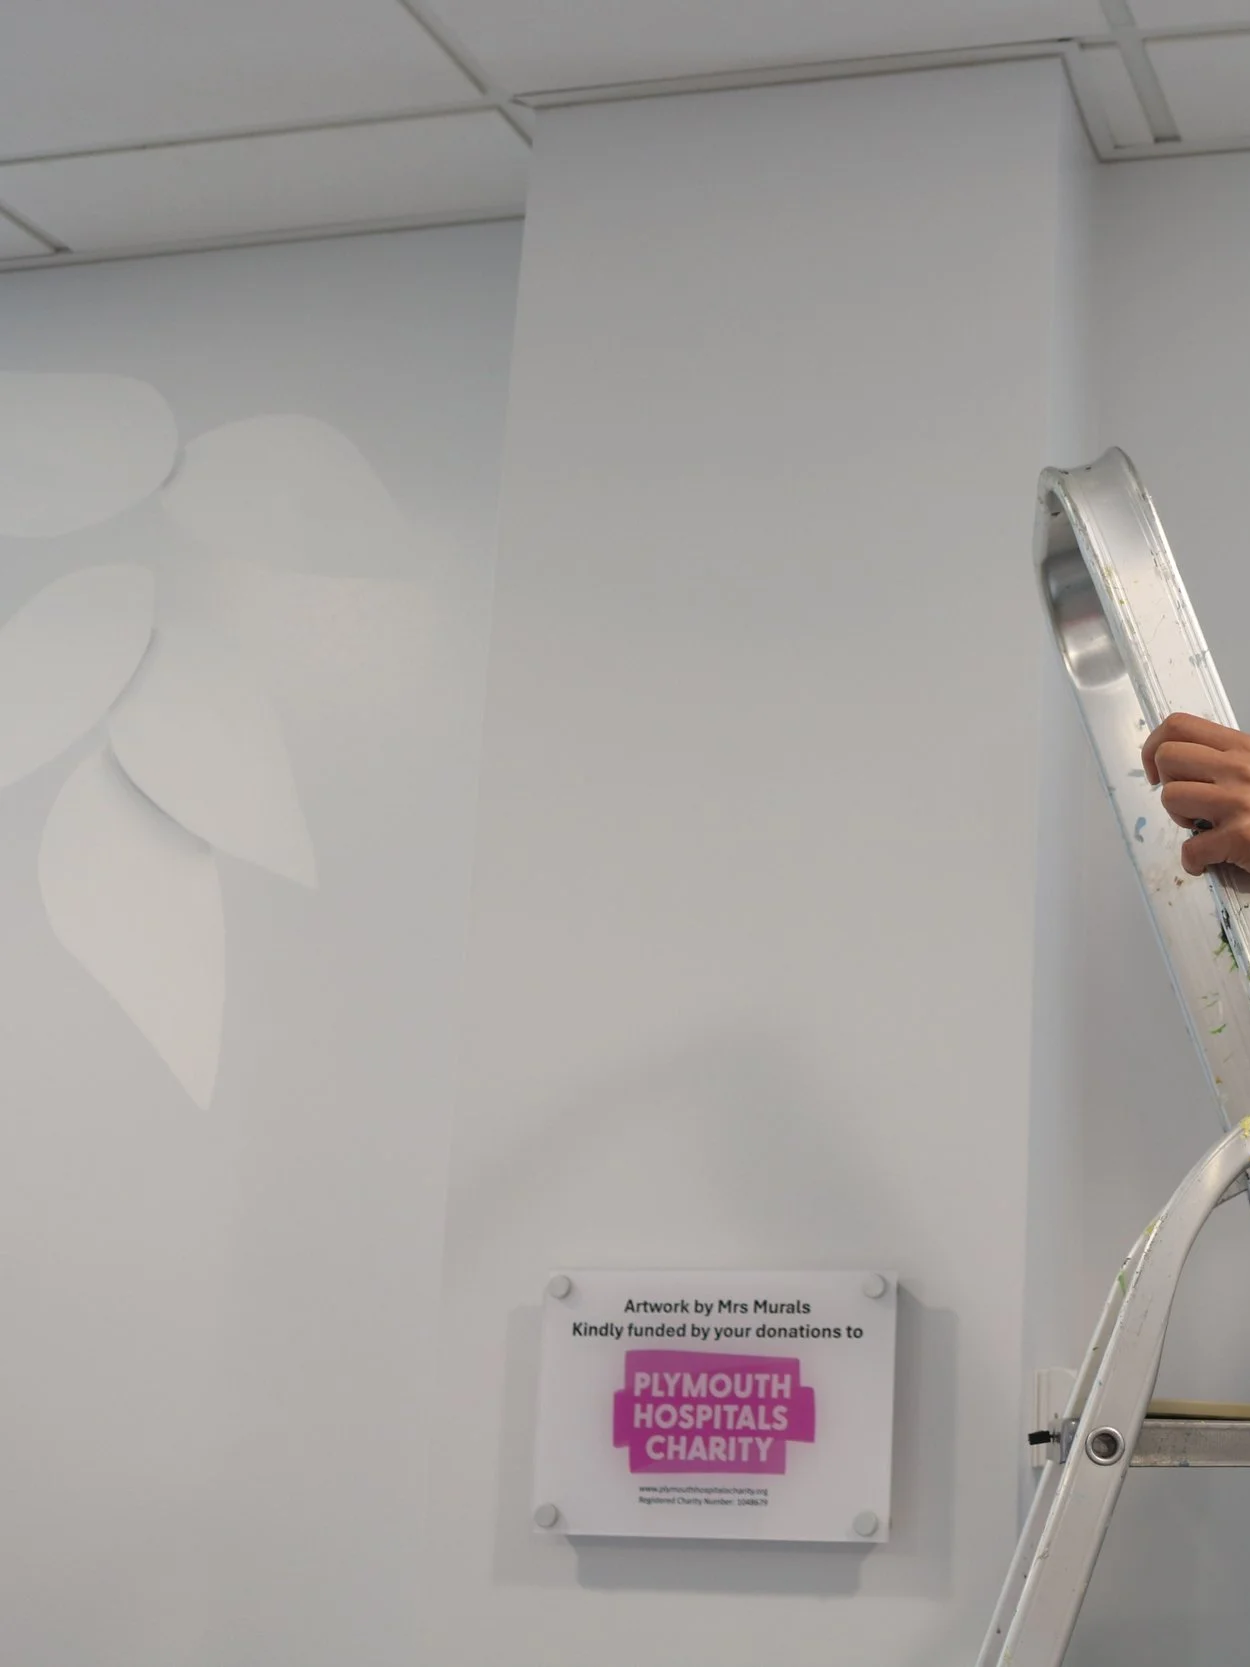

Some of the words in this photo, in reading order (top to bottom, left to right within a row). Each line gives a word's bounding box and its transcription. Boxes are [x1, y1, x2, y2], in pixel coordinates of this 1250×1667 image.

[624, 1299, 690, 1314] Artwork
[694, 1300, 713, 1316] by
[717, 1300, 749, 1314] Mrs
[753, 1300, 811, 1314] Murals
[572, 1322, 624, 1340] Kindly
[627, 1323, 687, 1338] funded
[691, 1323, 710, 1341] by
[714, 1327, 751, 1341] your
[756, 1324, 842, 1339] donations
[846, 1326, 864, 1339] to
[633, 1371, 792, 1399] PLYMOUTH
[633, 1403, 789, 1431] HOSPITALS
[645, 1435, 775, 1462] CHARITY
[638, 1496, 676, 1506] Registered
[677, 1497, 702, 1507] Charity
